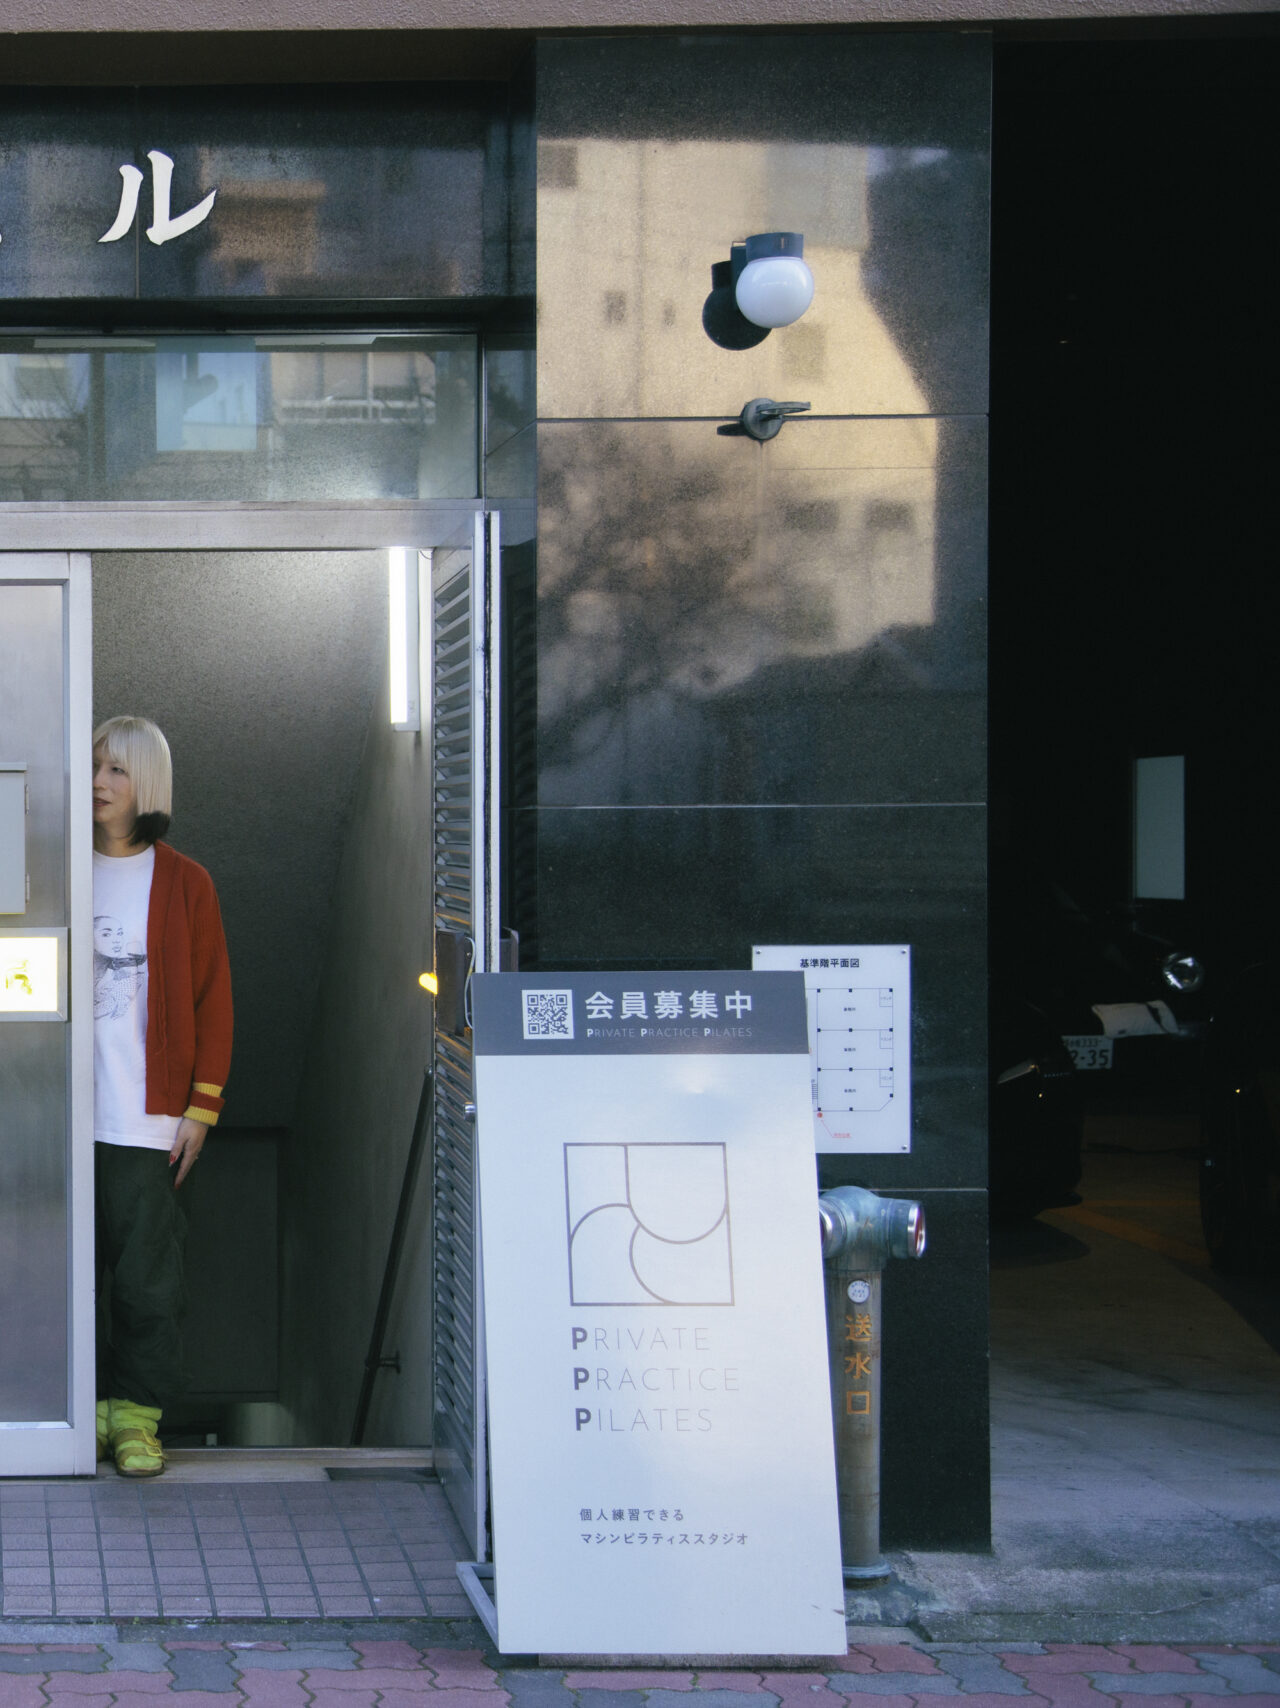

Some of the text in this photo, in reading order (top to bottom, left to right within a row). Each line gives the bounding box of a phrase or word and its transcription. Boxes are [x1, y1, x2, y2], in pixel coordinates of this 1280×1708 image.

[800, 958, 860, 968] 基準階平面図
[585, 990, 753, 1020] 会員募集中
[586, 1027, 753, 1038] PRIVATE PRACTICE PILATES
[571, 1326, 711, 1351] PRIVATE
[845, 1313, 873, 1415] 送水口
[573, 1367, 740, 1391] PRACTICE
[575, 1407, 713, 1432] PILATES
[580, 1508, 685, 1522] 個人練習できる
[580, 1532, 749, 1545] マシンピラティススタジオ
